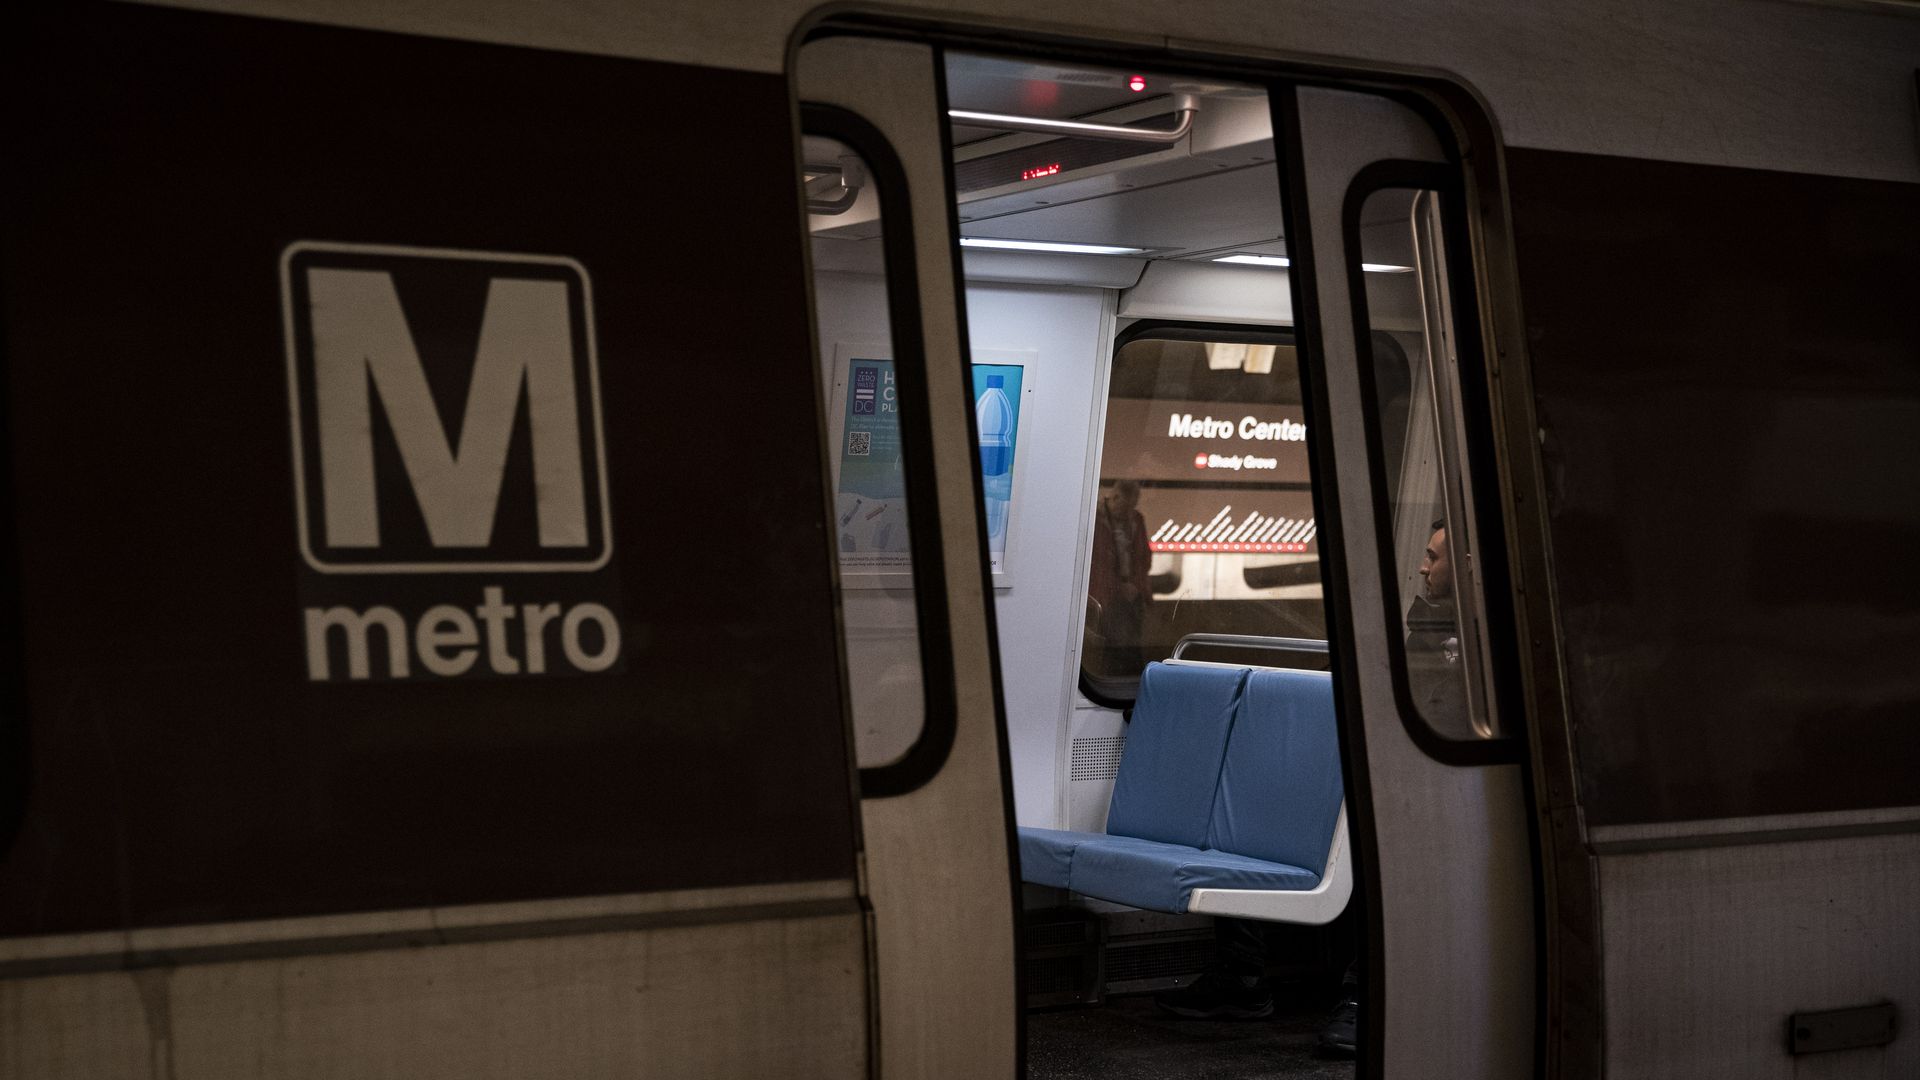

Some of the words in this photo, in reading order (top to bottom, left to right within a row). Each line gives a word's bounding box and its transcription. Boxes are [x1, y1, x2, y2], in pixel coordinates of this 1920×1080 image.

[307, 267, 589, 548] M
[855, 400, 874, 413] DC
[1168, 413, 1234, 440] Metro
[1238, 415, 1306, 442] Center
[1207, 454, 1243, 471] Shady
[1243, 455, 1278, 470] Grove
[304, 587, 621, 681] metro
